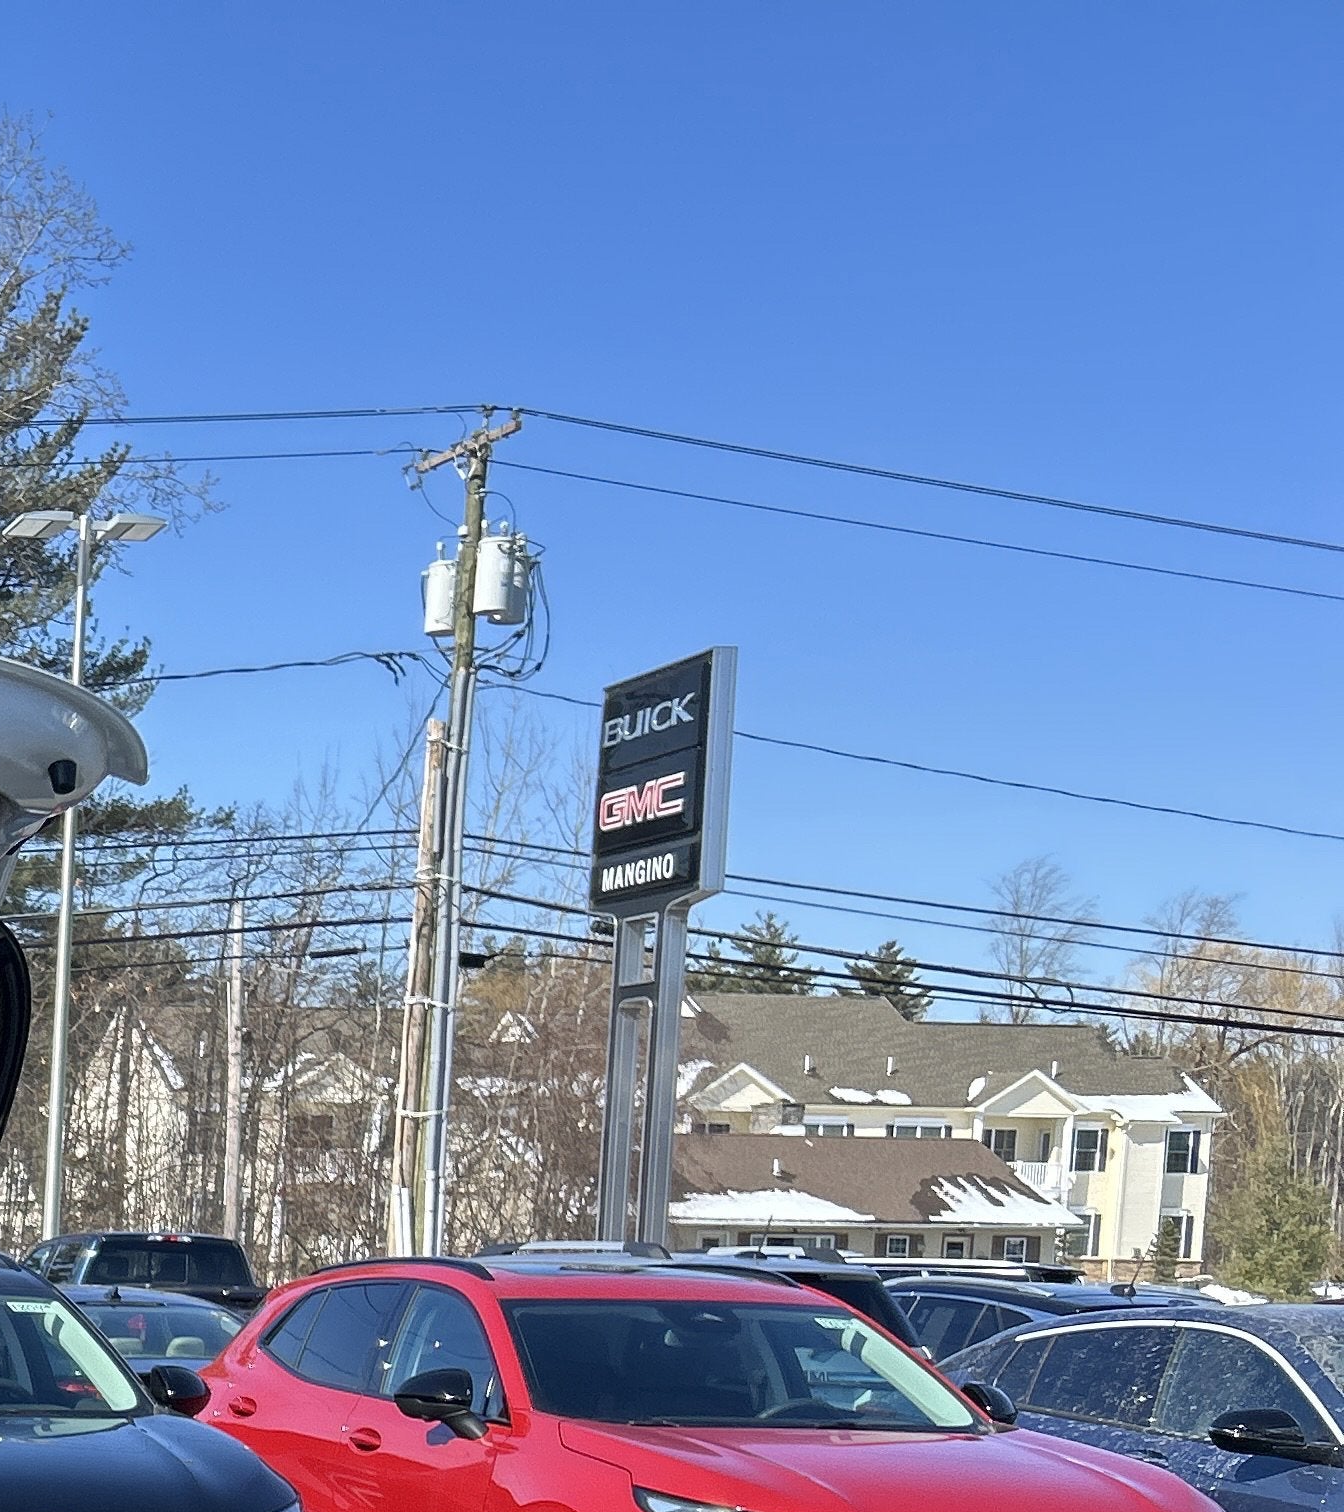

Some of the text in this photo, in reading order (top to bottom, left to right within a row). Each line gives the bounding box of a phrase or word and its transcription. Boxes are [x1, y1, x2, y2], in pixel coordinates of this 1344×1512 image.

[602, 692, 696, 749] BUICK
[599, 771, 686, 832] GMC
[602, 852, 675, 893] MANGINO
